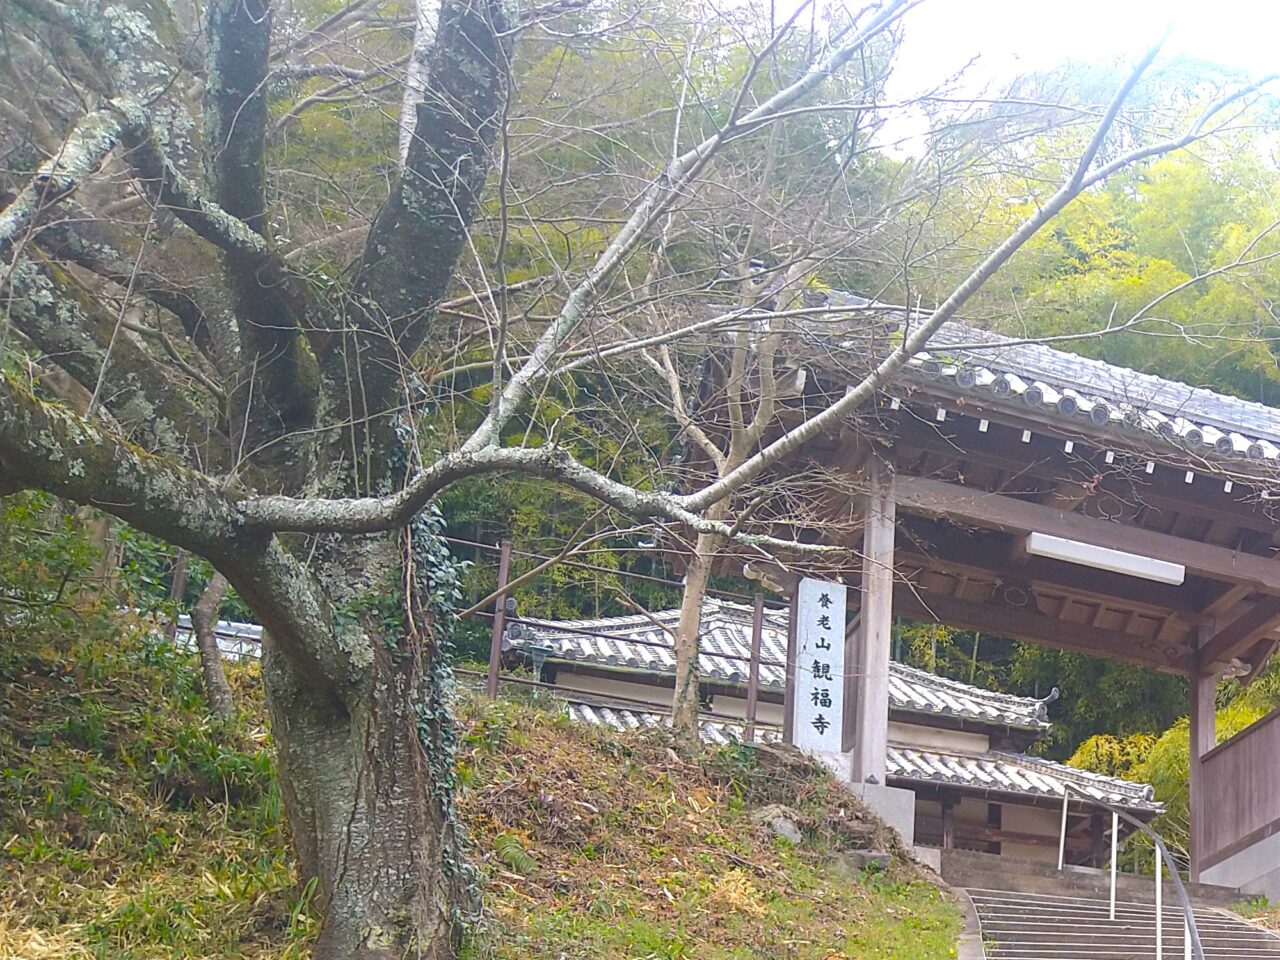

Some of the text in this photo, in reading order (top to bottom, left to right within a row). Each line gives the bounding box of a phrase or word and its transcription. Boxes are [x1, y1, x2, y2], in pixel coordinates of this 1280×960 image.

[809, 592, 834, 736] 養老山観福寺
